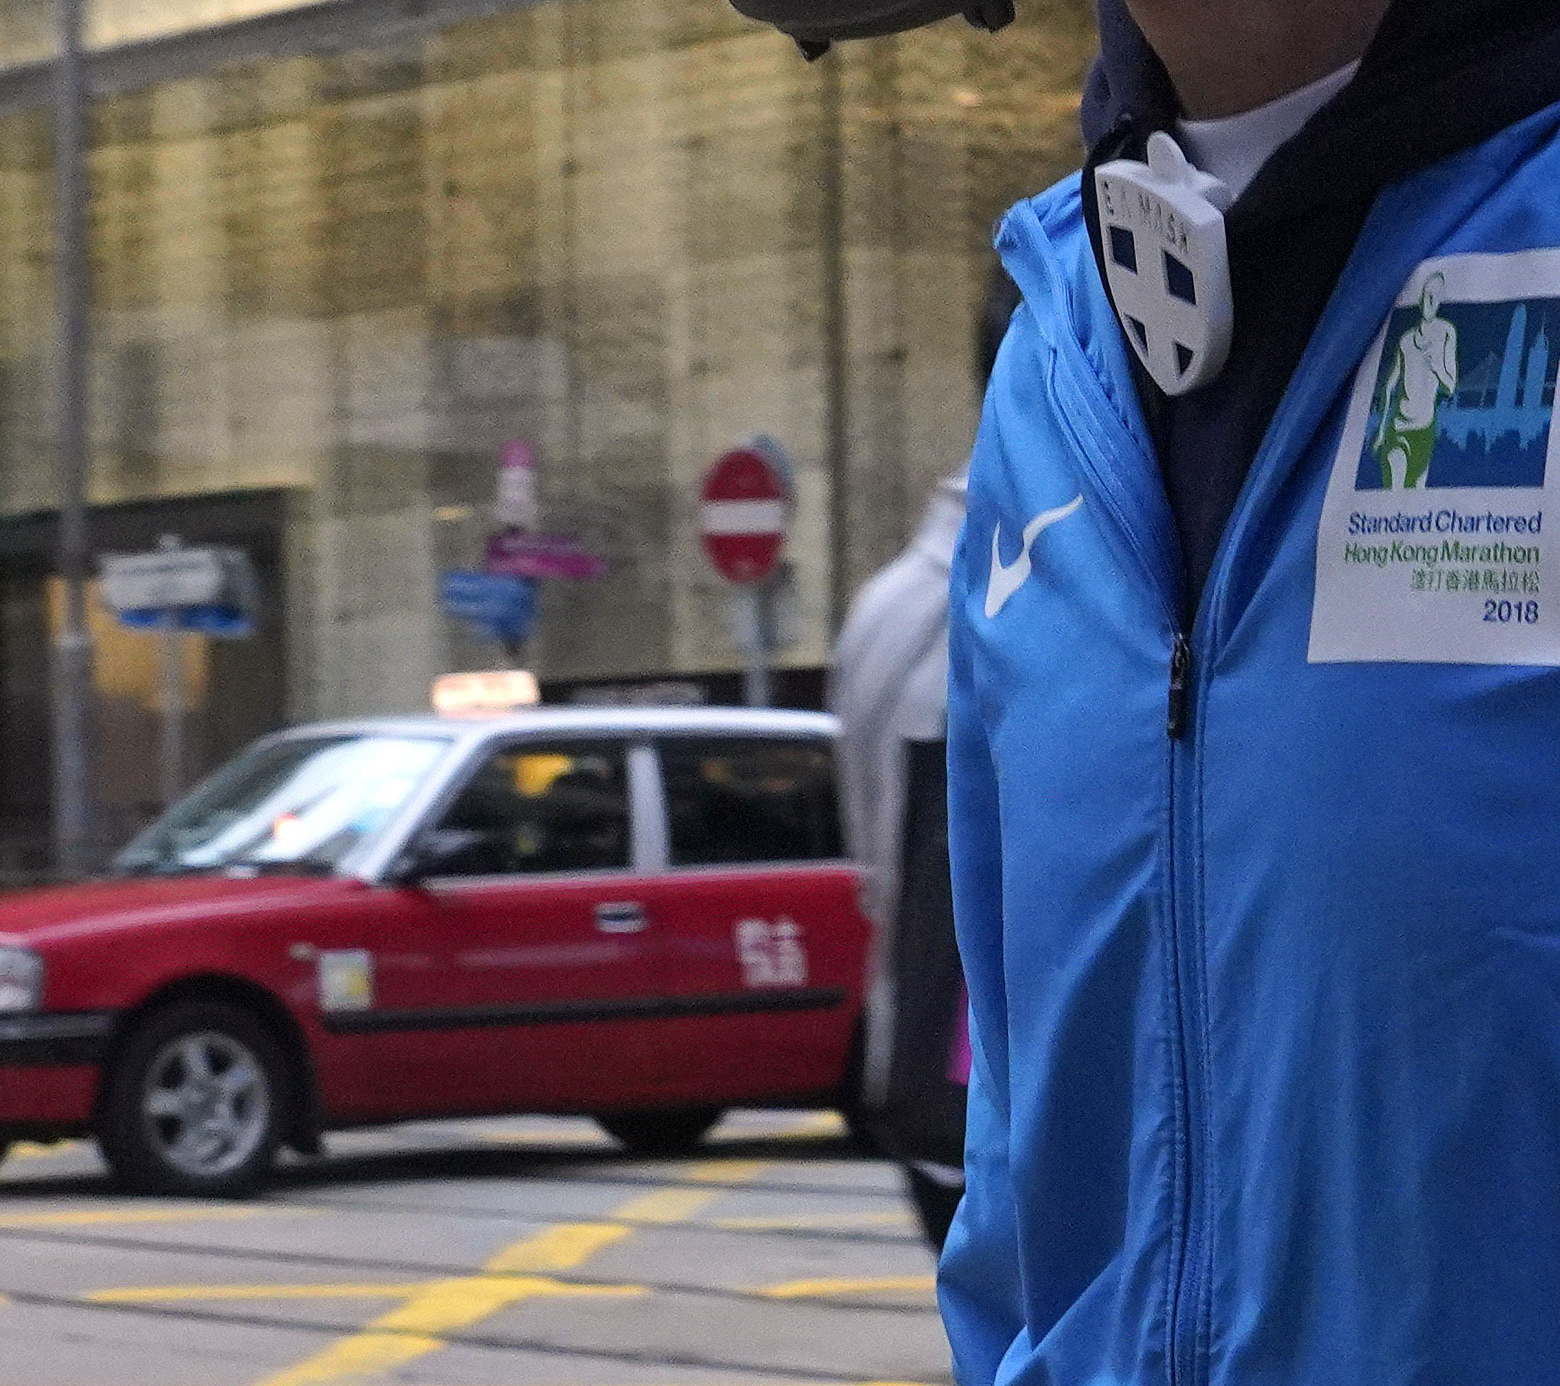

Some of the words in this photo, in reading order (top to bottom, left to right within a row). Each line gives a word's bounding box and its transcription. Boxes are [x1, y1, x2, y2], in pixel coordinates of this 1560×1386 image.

[1348, 510, 1432, 535] Standard
[1435, 510, 1542, 535] Chartered
[1344, 540, 1388, 568] Hong
[1389, 539, 1439, 568] Kong
[1440, 539, 1539, 563] Marathon
[1483, 599, 1539, 623] 2018
